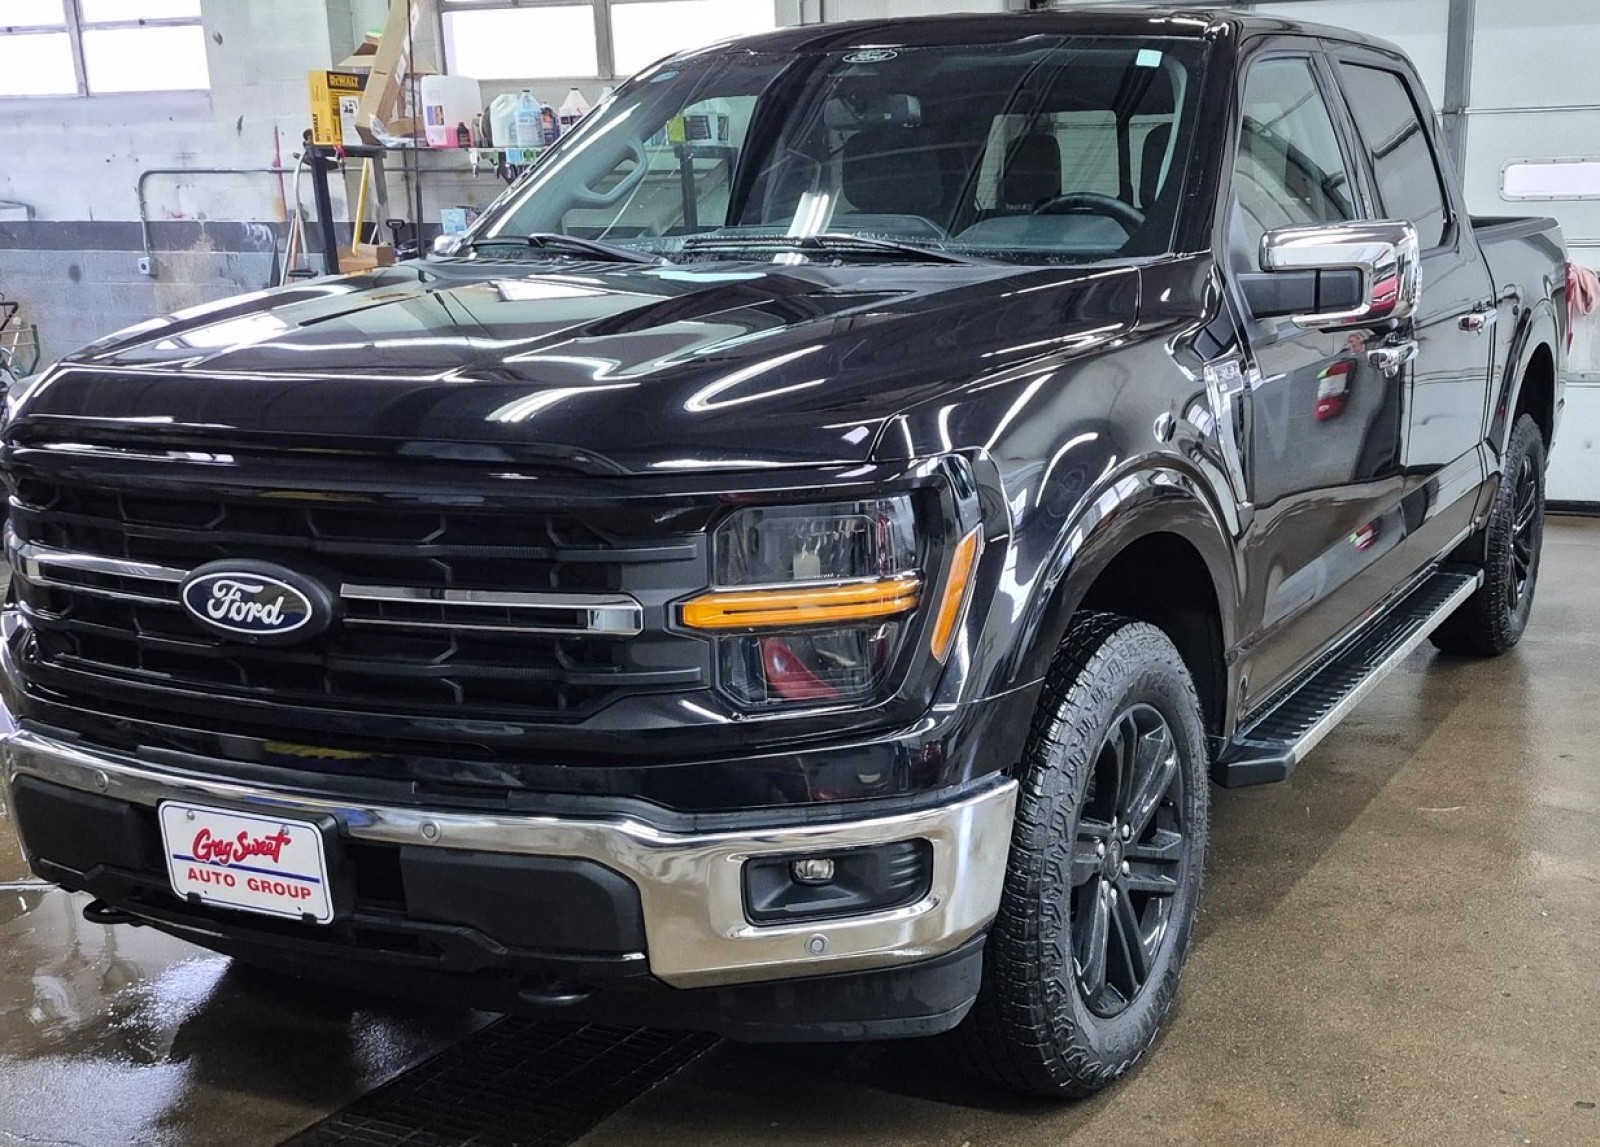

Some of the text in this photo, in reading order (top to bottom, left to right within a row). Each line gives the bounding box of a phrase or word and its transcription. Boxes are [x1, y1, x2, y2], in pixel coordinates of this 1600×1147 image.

[207, 579, 285, 625] Ford
[192, 828, 292, 864] Greg Sweet
[187, 867, 312, 900] AUTO GROUP
